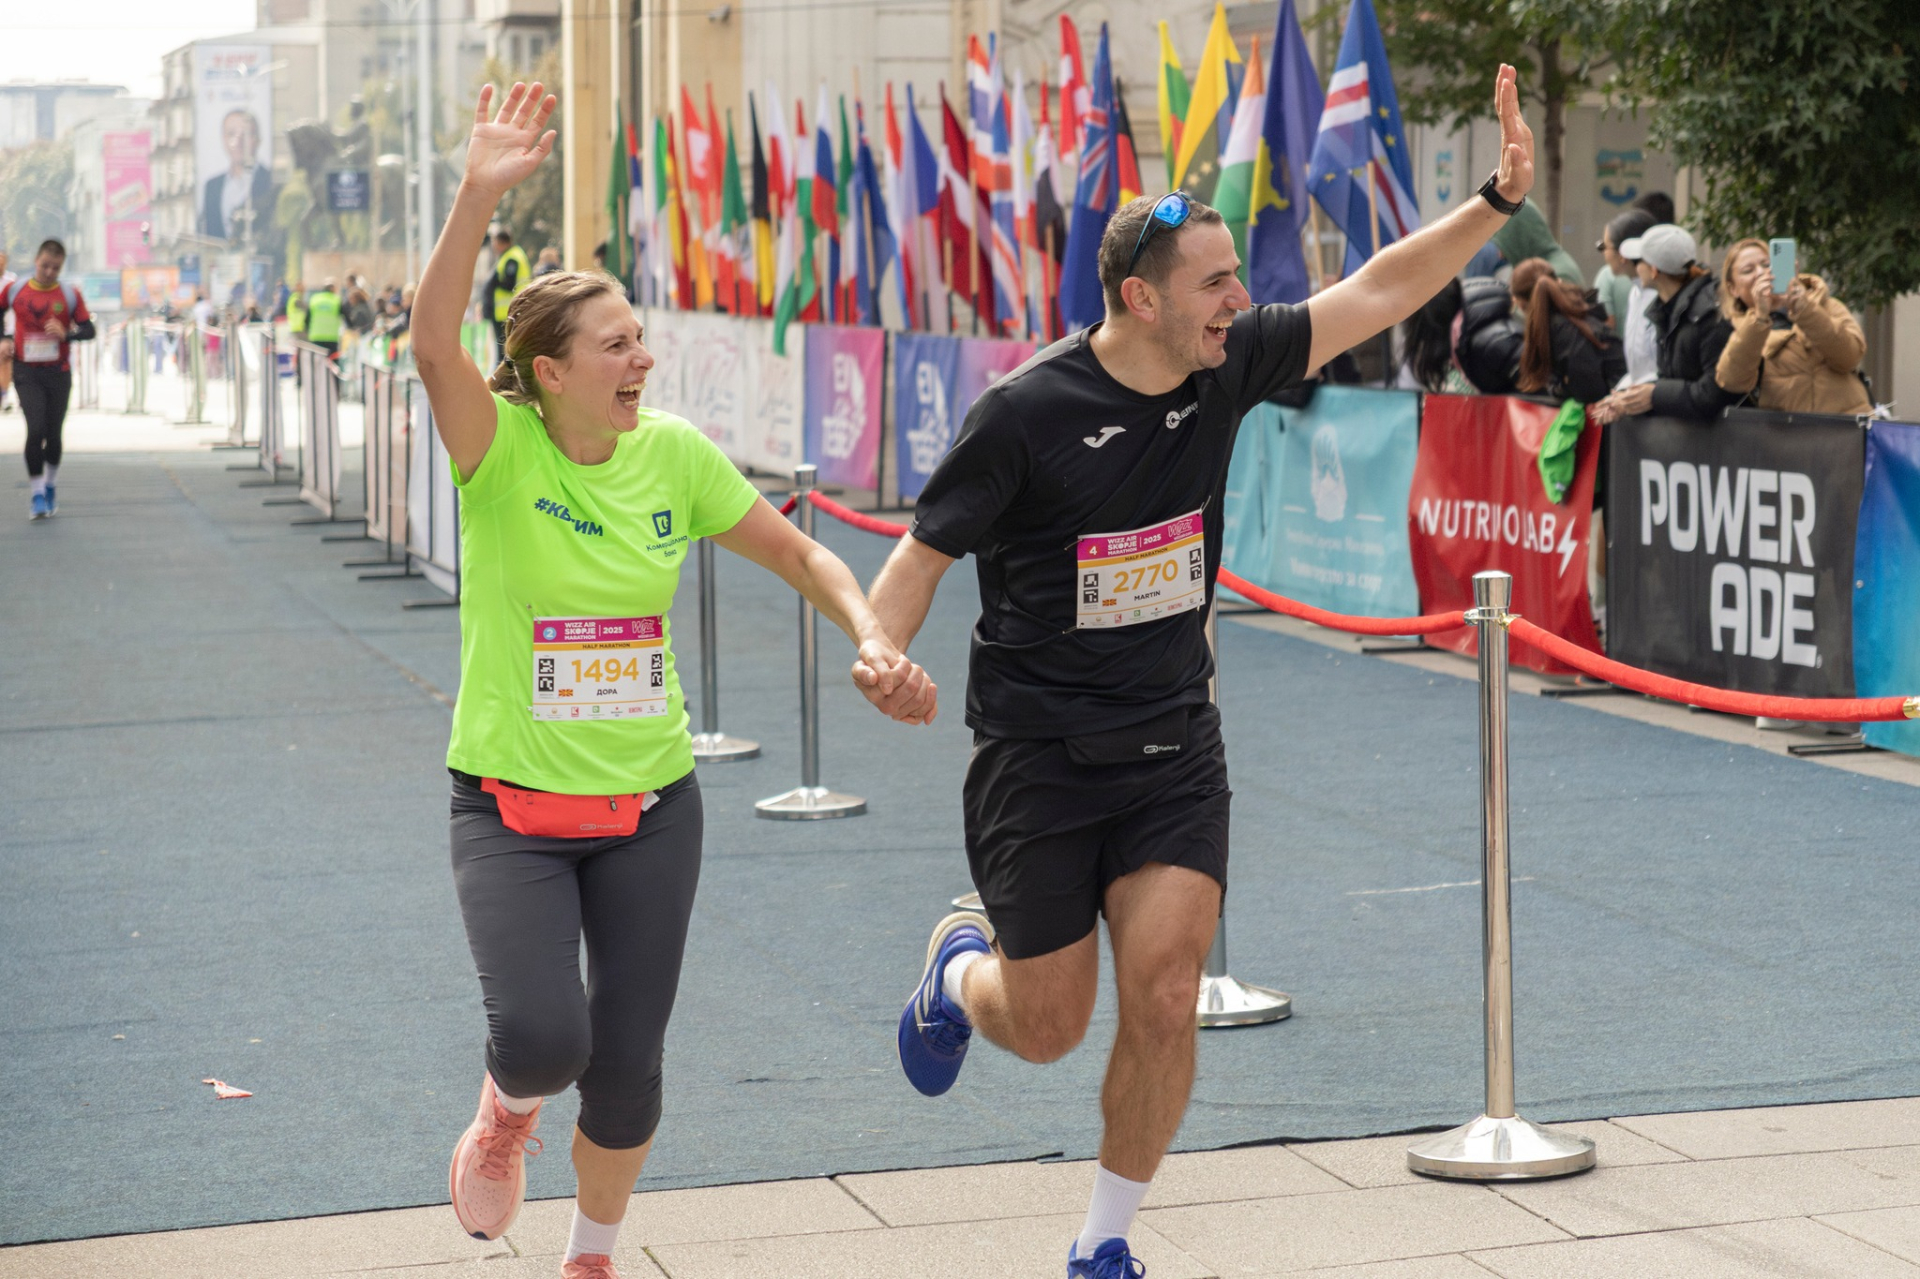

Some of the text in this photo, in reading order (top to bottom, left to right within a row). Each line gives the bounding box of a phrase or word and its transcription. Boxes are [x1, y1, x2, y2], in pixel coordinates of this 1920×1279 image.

[1640, 459, 1816, 567] POWER
[1126, 535, 1137, 543] AIR
[1143, 534, 1162, 545] 2025
[1089, 546, 1098, 556] 4
[1107, 541, 1137, 551] SKOPJE
[1107, 547, 1137, 556] MARATHON
[1140, 547, 1168, 559] MARATHON
[1113, 559, 1179, 594] 2770
[1134, 590, 1161, 602] MARTIN
[546, 629, 554, 638] 2
[603, 626, 623, 635] 2025
[571, 658, 639, 683] 1494
[596, 688, 618, 697] ДОРА
